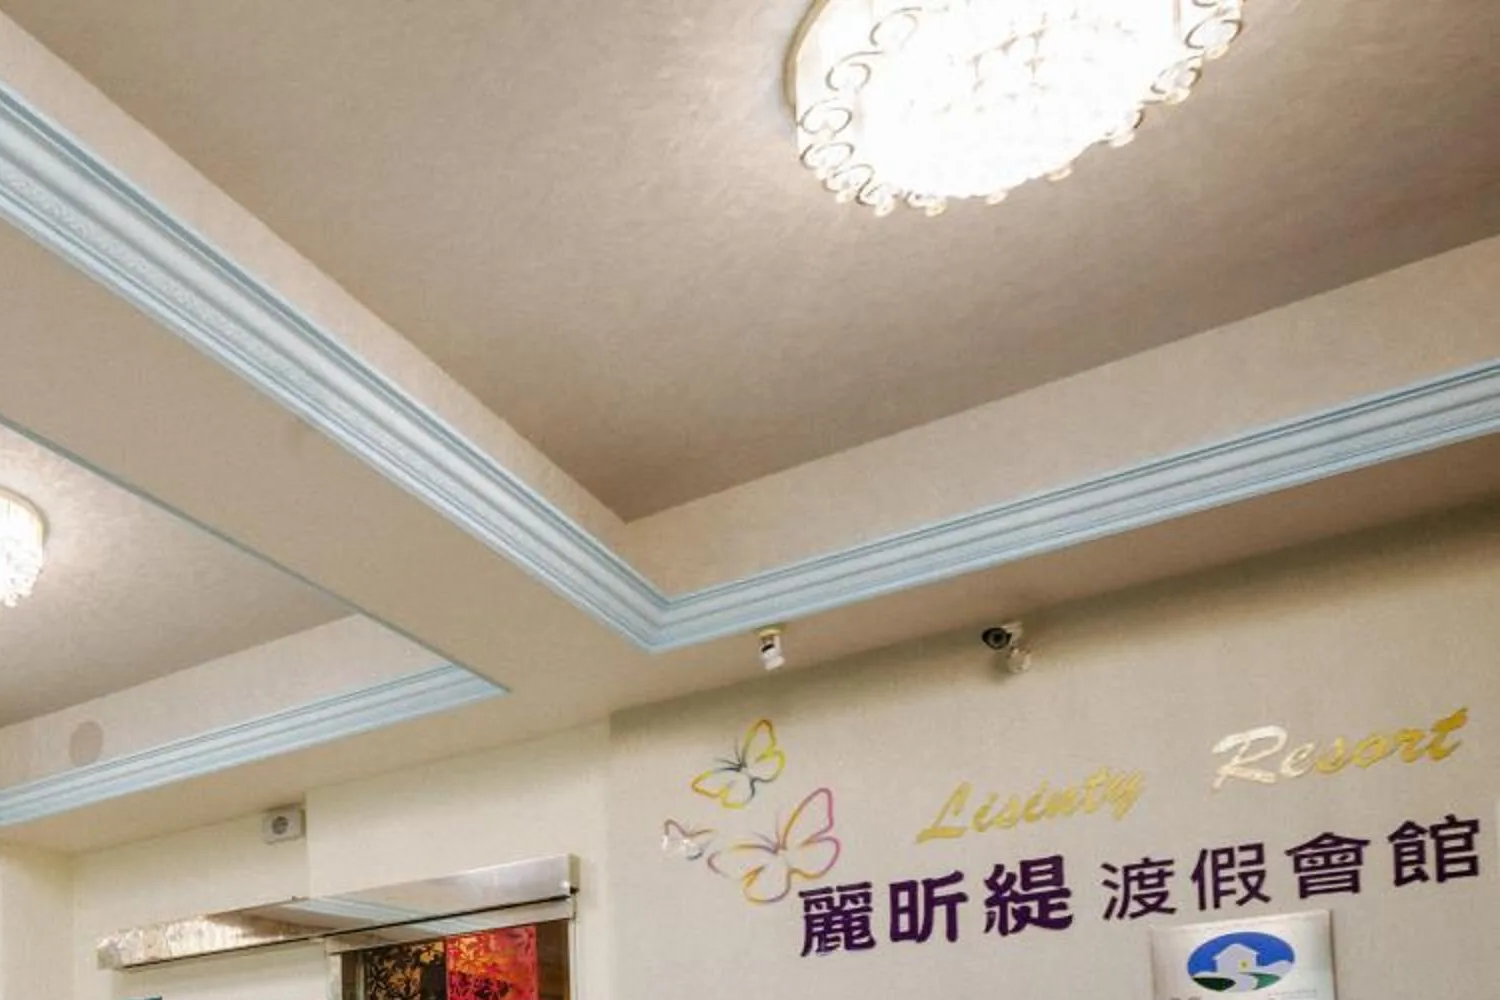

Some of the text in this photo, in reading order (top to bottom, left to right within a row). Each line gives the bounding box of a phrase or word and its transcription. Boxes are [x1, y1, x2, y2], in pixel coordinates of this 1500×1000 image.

[1211, 707, 1470, 791] Resort
[798, 814, 1481, 958] 麗昕緹渡假會館
